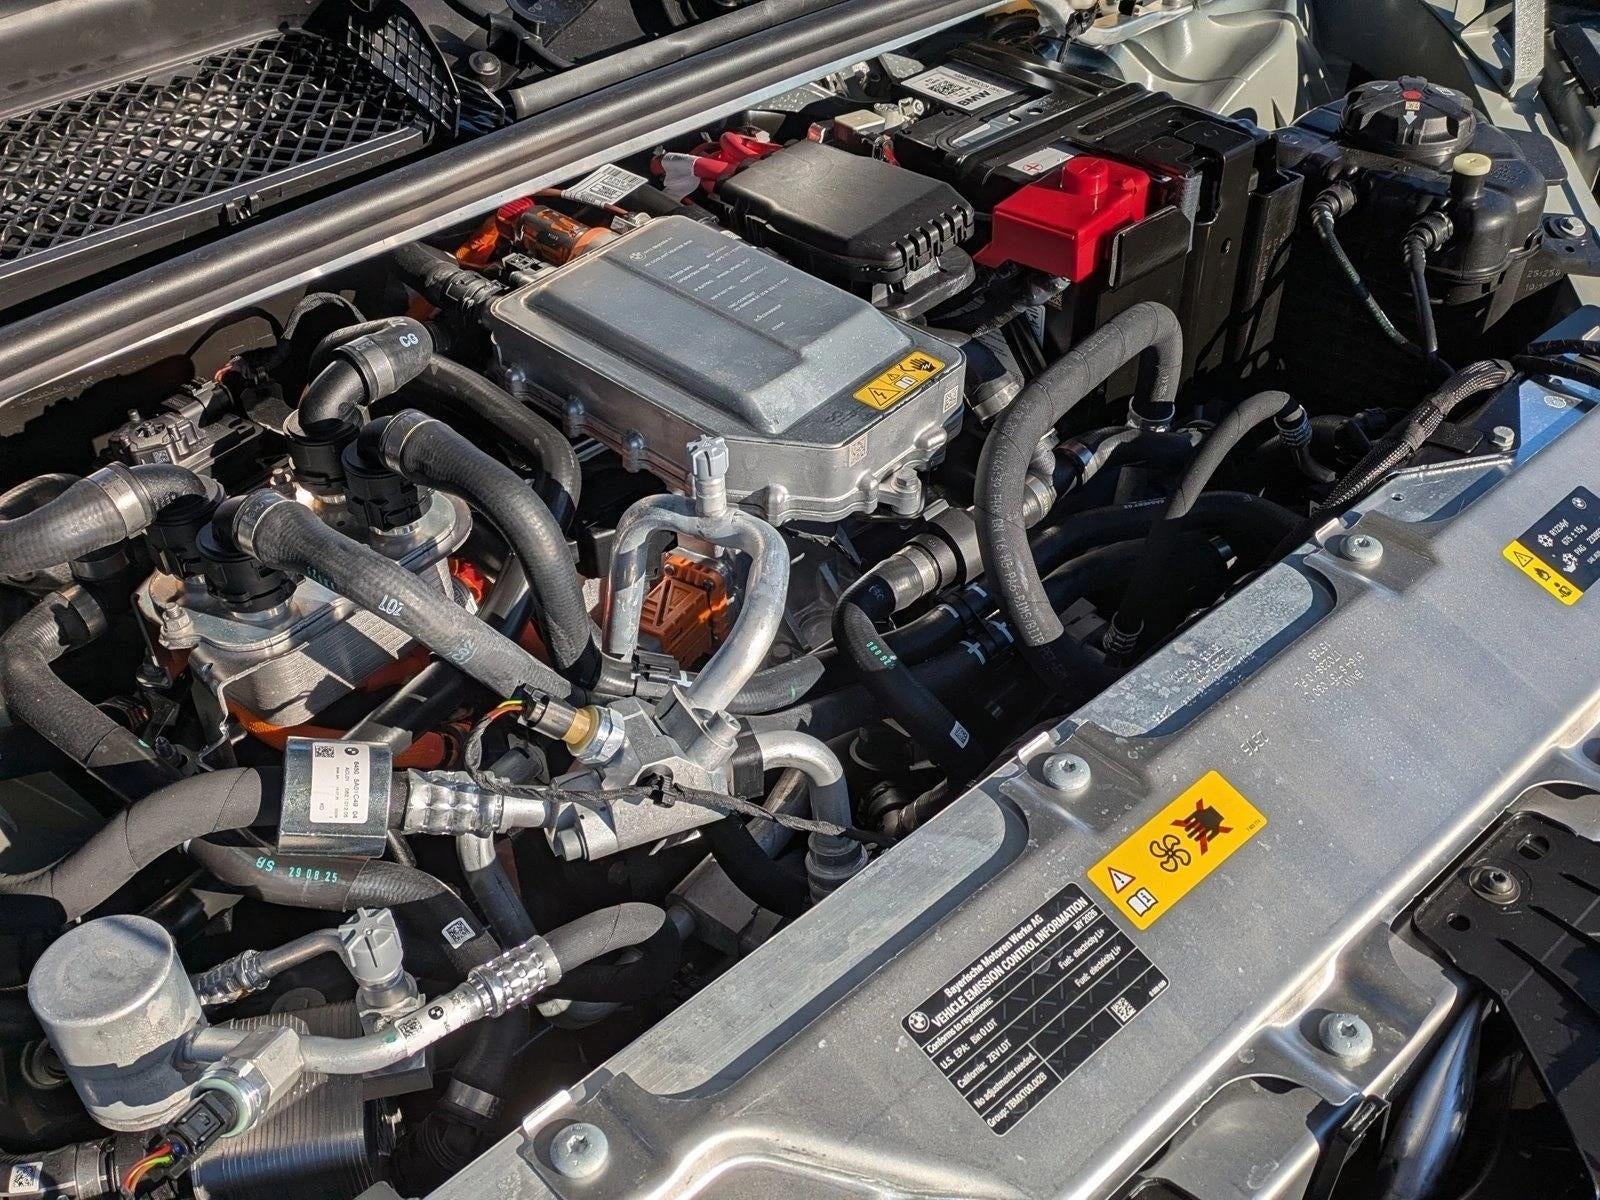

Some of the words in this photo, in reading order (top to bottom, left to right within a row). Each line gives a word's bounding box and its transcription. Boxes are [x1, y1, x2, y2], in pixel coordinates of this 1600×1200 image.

[955, 88, 992, 108] BMW
[399, 333, 419, 347] CG
[1561, 535, 1573, 546] 675
[1574, 525, 1583, 534] 15
[1573, 544, 1587, 556] PAG
[289, 867, 301, 877] 29
[306, 868, 320, 880] 08
[324, 872, 338, 883] 25
[1072, 919, 1085, 931] MY
[1080, 908, 1098, 924] 2026
[930, 994, 969, 1029] VEHICLE
[962, 964, 1005, 1002] EMISSION
[999, 935, 1040, 971] CONTROL
[1034, 895, 1089, 943] INFORMATION
[943, 960, 988, 999] Bayerische
[982, 938, 1014, 966] Motoren
[1008, 923, 1031, 945] Werke
[1026, 913, 1044, 930] AG
[1057, 954, 1075, 970] Fuel:
[1071, 934, 1099, 960] electricity
[1073, 971, 1091, 988] Fuel:
[1087, 951, 1116, 977] electricity
[925, 1026, 957, 1054] Conforms
[952, 1021, 963, 1032] to
[958, 995, 995, 1027] regulations:
[939, 1054, 956, 1070] U.S.
[952, 1041, 971, 1058] EPA:
[969, 1031, 983, 1045] Bin
[982, 1018, 999, 1033] LDT
[955, 1059, 988, 1089] California:
[985, 1048, 1002, 1063] ZEV
[997, 1038, 1013, 1054] LDT
[972, 1095, 986, 1108] No
[980, 1068, 1018, 1102] adjustments
[1011, 1050, 1038, 1075] needed.
[985, 1105, 1011, 1130] Group:
